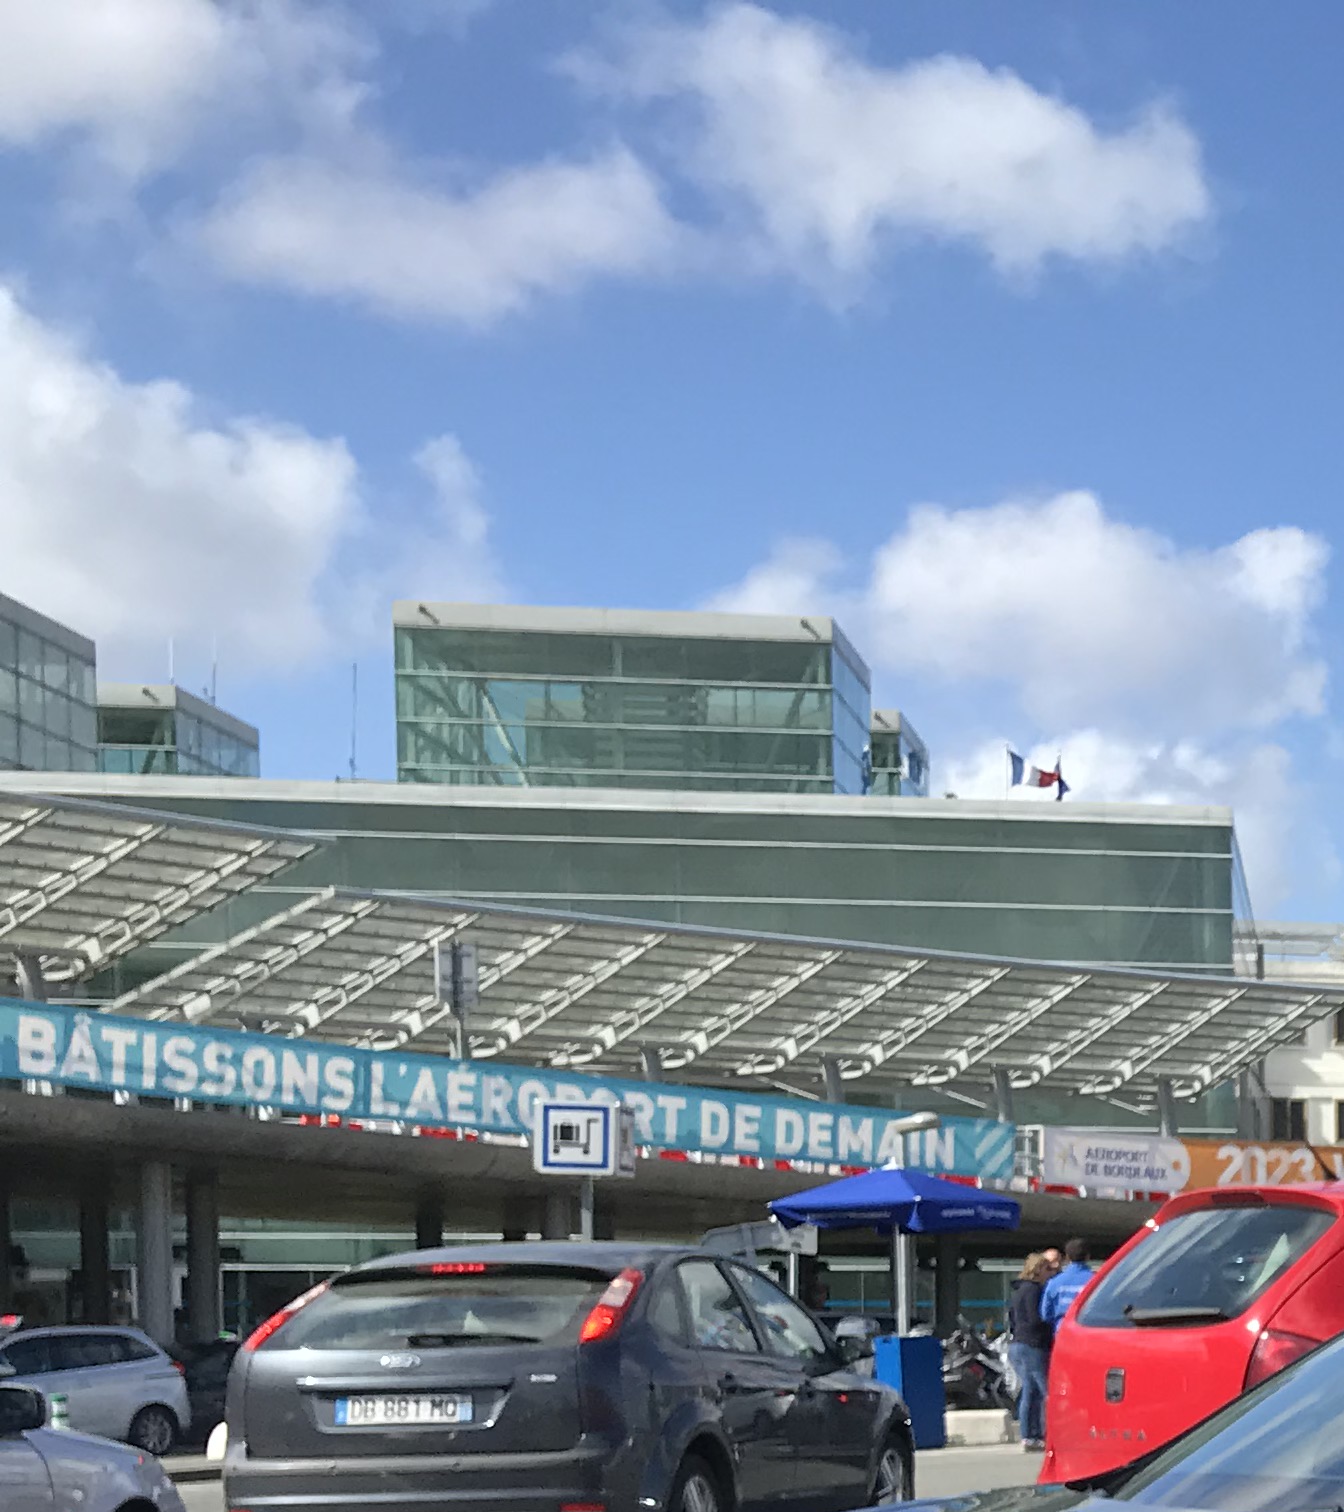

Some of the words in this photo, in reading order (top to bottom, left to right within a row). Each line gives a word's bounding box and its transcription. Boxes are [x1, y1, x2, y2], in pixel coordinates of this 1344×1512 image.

[17, 1012, 355, 1111] BÂTISSONS
[371, 1061, 687, 1143] L'AÉRORT
[700, 1099, 762, 1152] DE
[774, 1108, 955, 1169] DEMAIN
[1216, 1144, 1316, 1186] 2023
